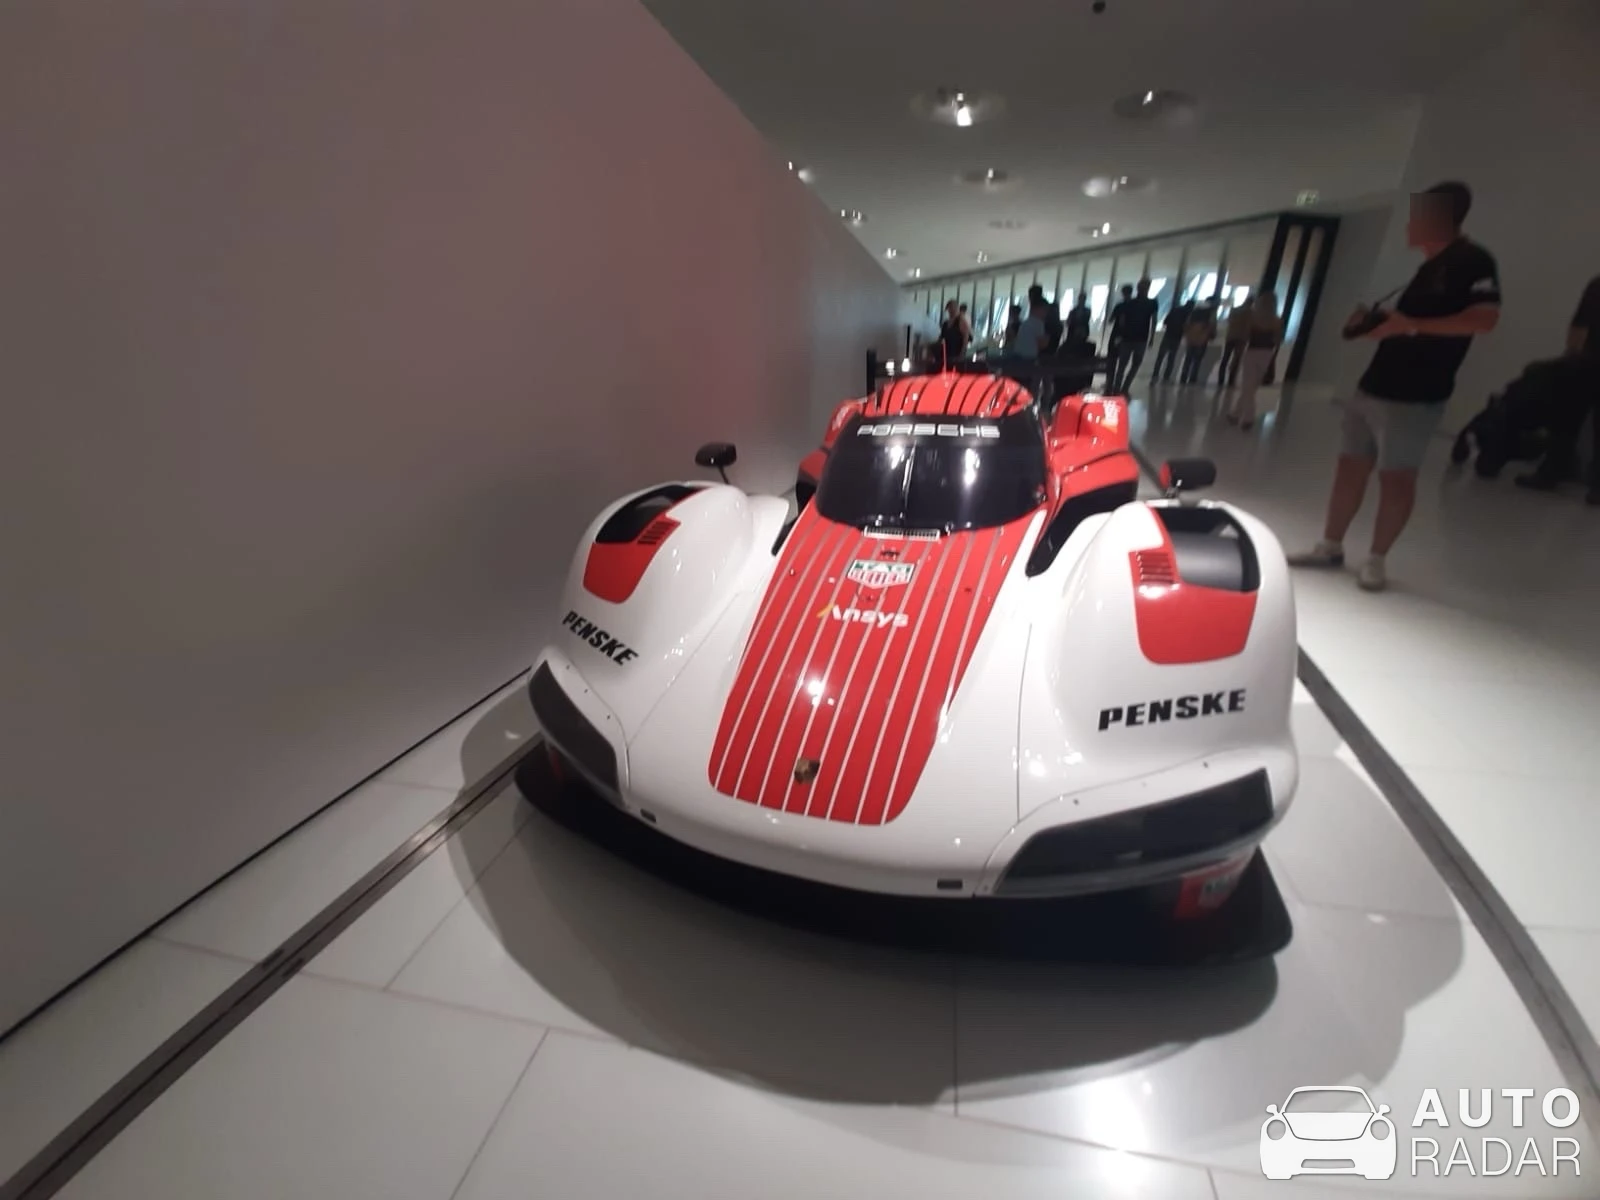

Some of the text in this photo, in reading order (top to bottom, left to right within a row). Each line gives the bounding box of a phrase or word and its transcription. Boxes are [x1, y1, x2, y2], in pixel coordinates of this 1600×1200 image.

[857, 424, 1000, 438] PORSCHE
[816, 603, 909, 628] Ansys
[562, 610, 639, 666] PENSKE
[1098, 688, 1246, 731] PENSKE
